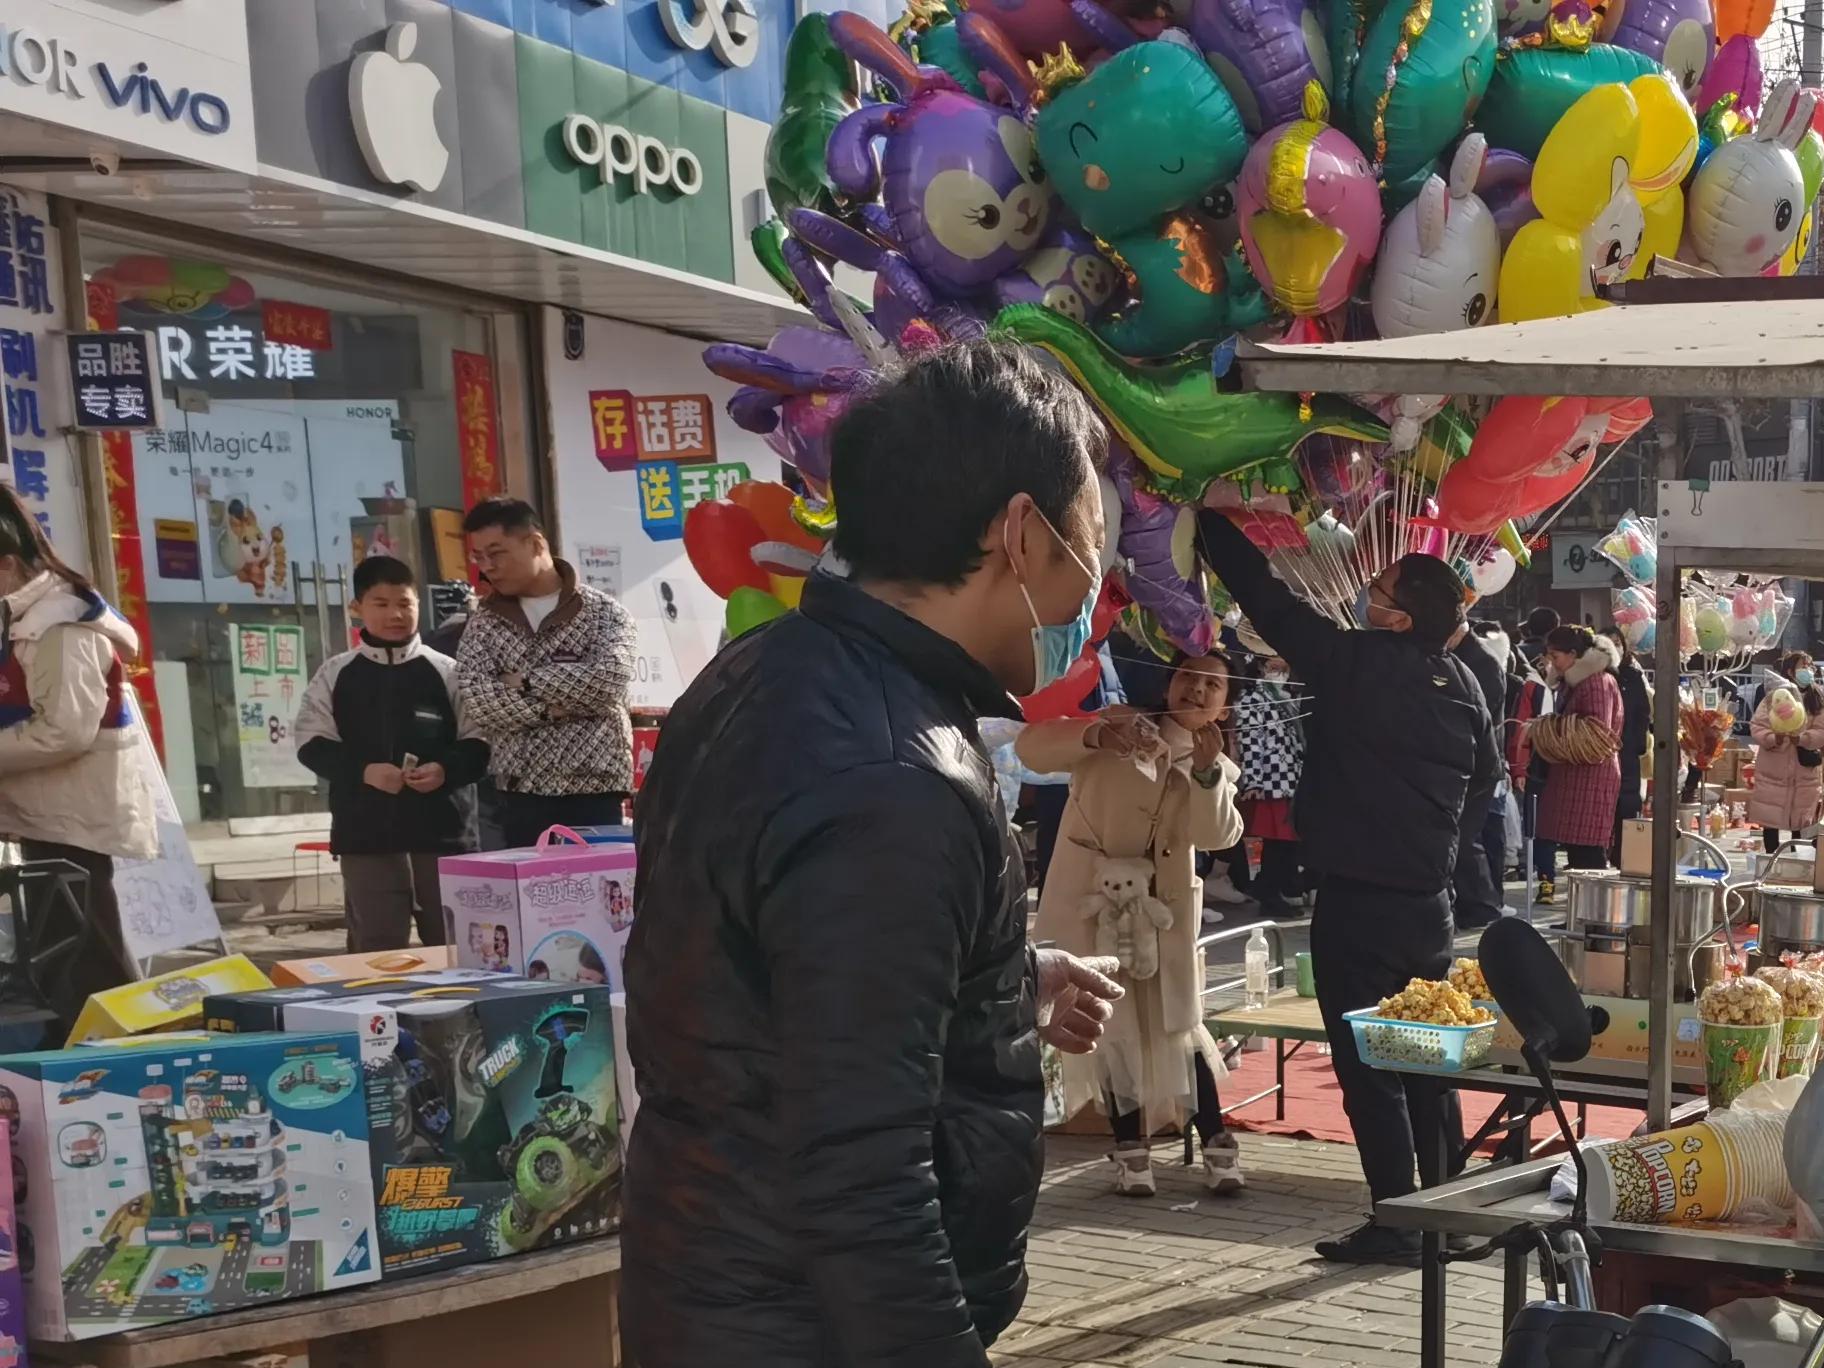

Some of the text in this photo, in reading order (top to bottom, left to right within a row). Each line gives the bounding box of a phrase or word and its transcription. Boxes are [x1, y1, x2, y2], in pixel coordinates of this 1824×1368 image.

[0, 23, 231, 135] OR vivo
[77, 343, 143, 378] 品胜
[347, 407, 394, 421] HONOR
[478, 1037, 521, 1081] TRUCK
[1636, 1140, 1676, 1214] POPCORN
